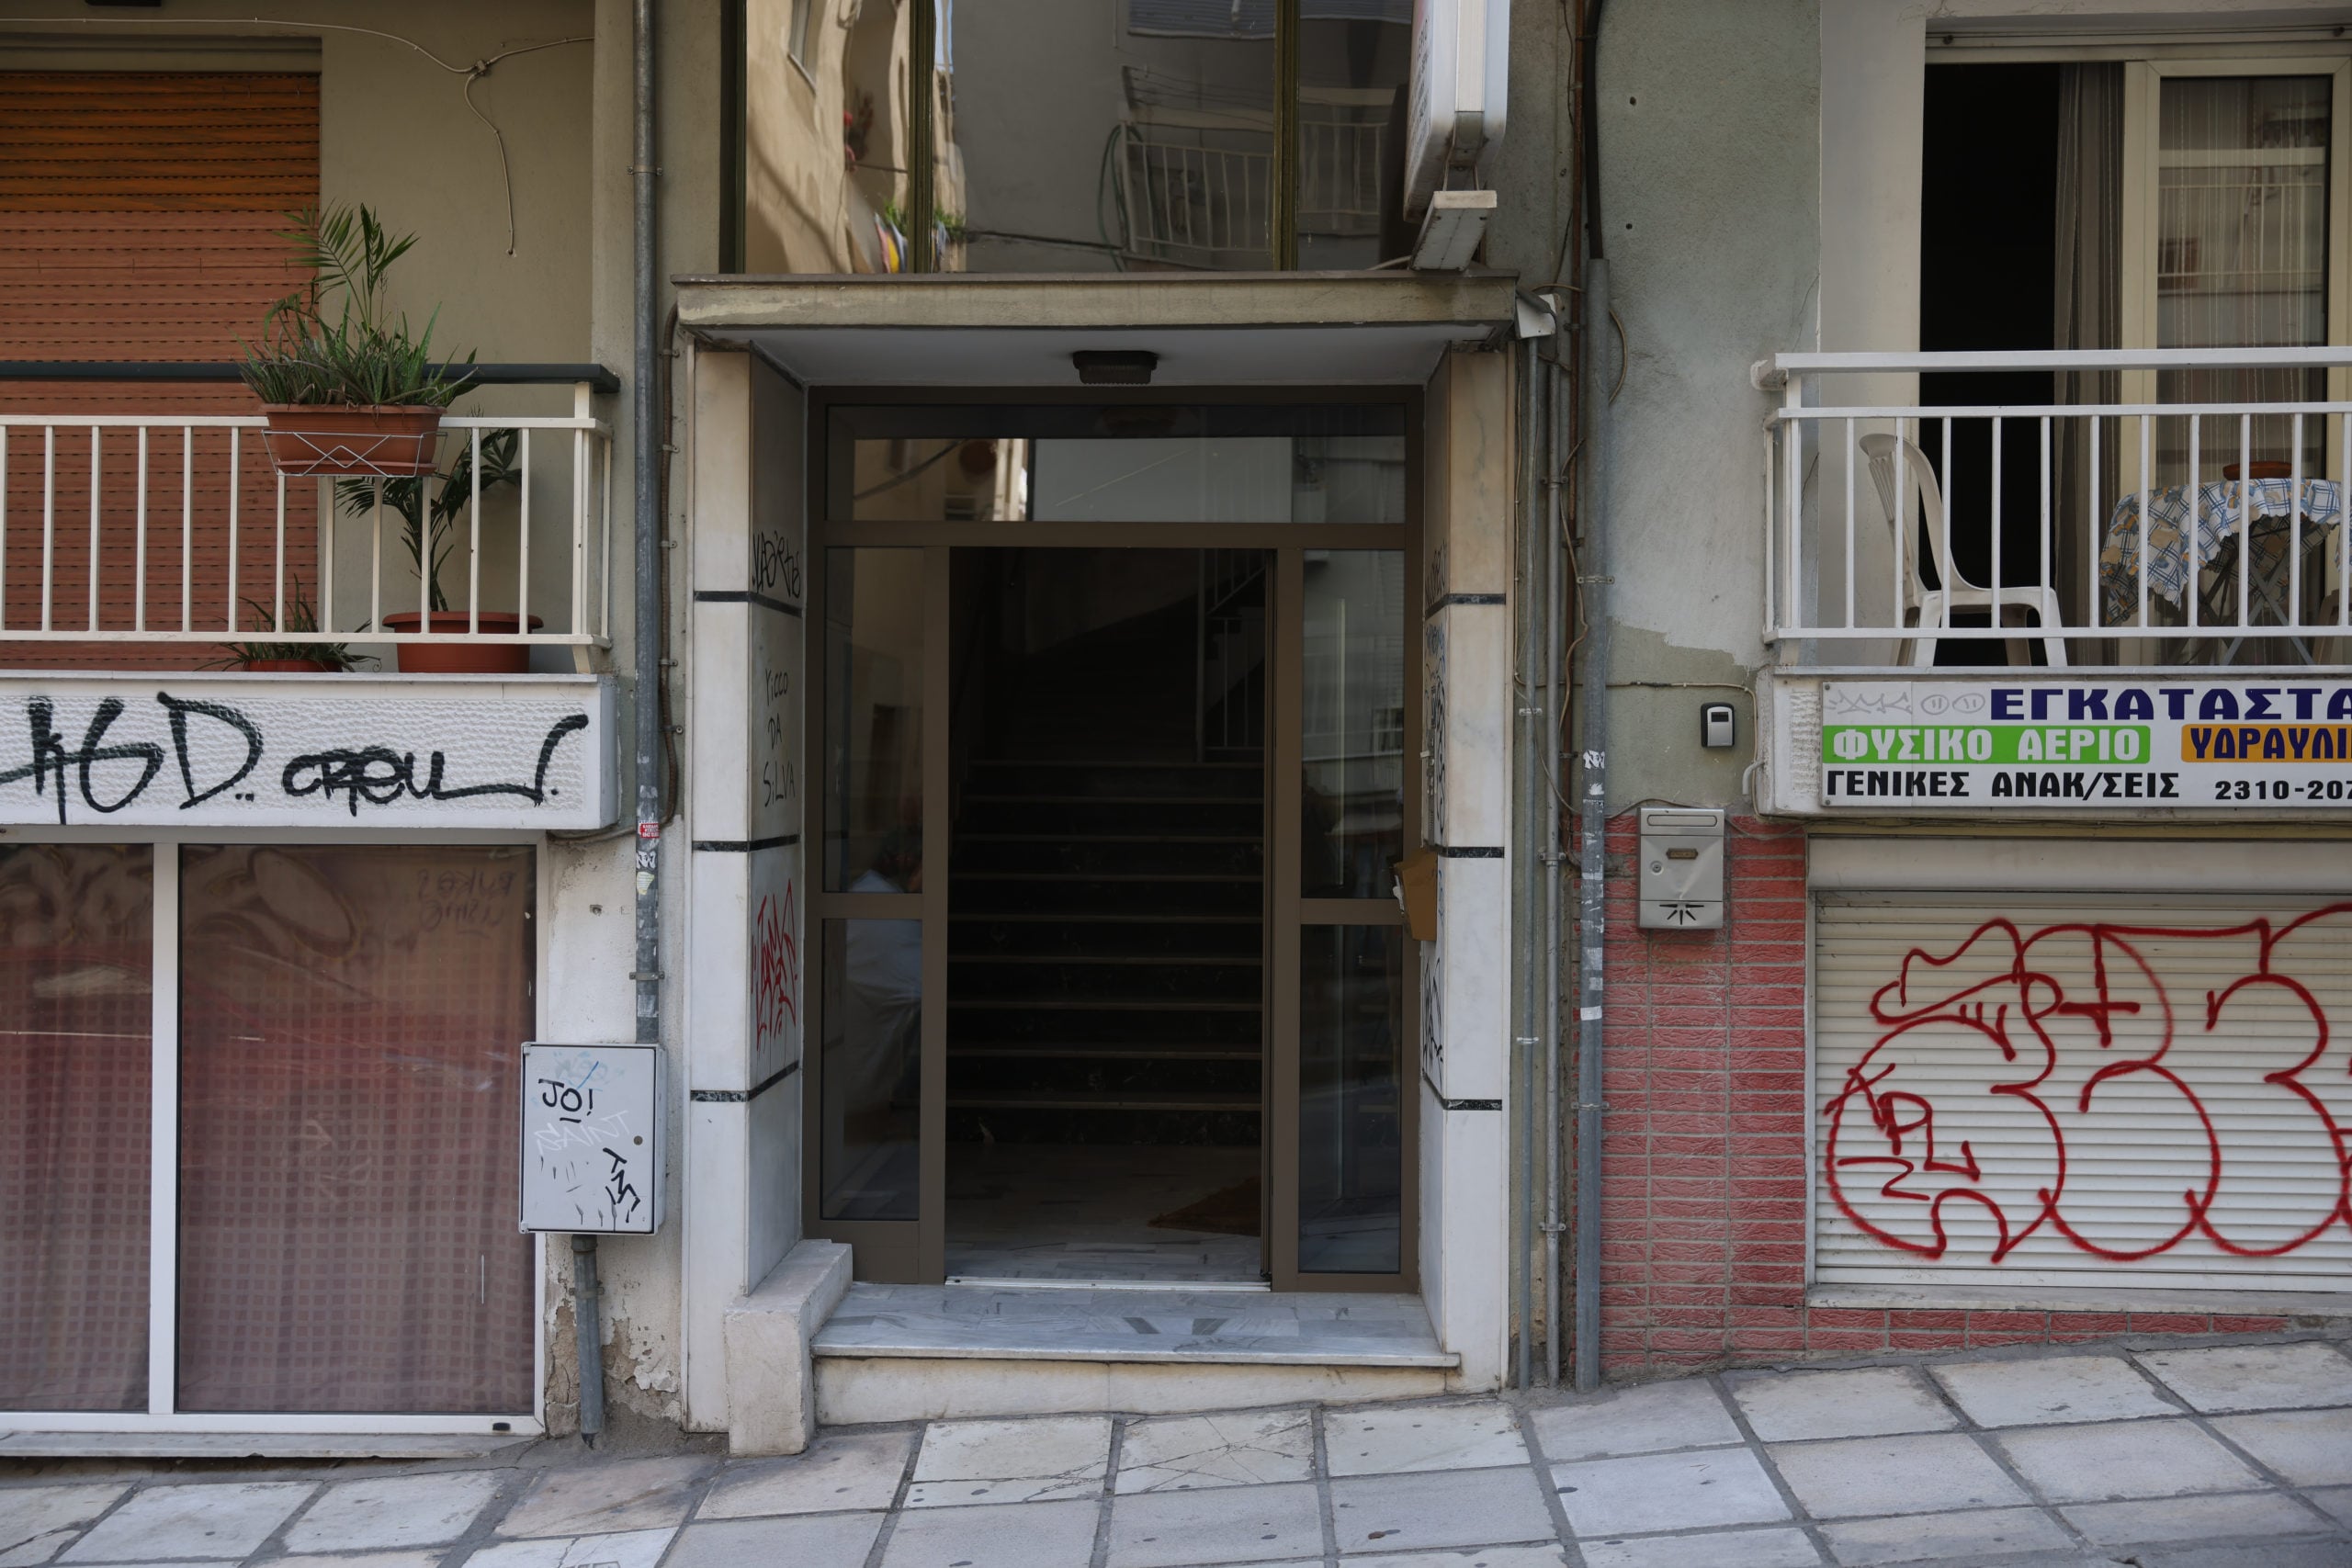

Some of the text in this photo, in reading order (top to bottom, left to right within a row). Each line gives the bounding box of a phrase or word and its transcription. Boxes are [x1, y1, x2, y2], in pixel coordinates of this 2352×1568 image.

[1990, 688, 2352, 720] ΕΓΚΑΤΑΣΤΑ
[1833, 728, 2140, 761] ΦΥΣΙΚΟ ΑΕΡΙΟ
[2190, 728, 2352, 760] ΥΔΡΑΥΛΙ
[1826, 770, 2180, 801] ΓΕΝΙΚΕΣ ΑΝΑΚ/ΣΕΙΣ
